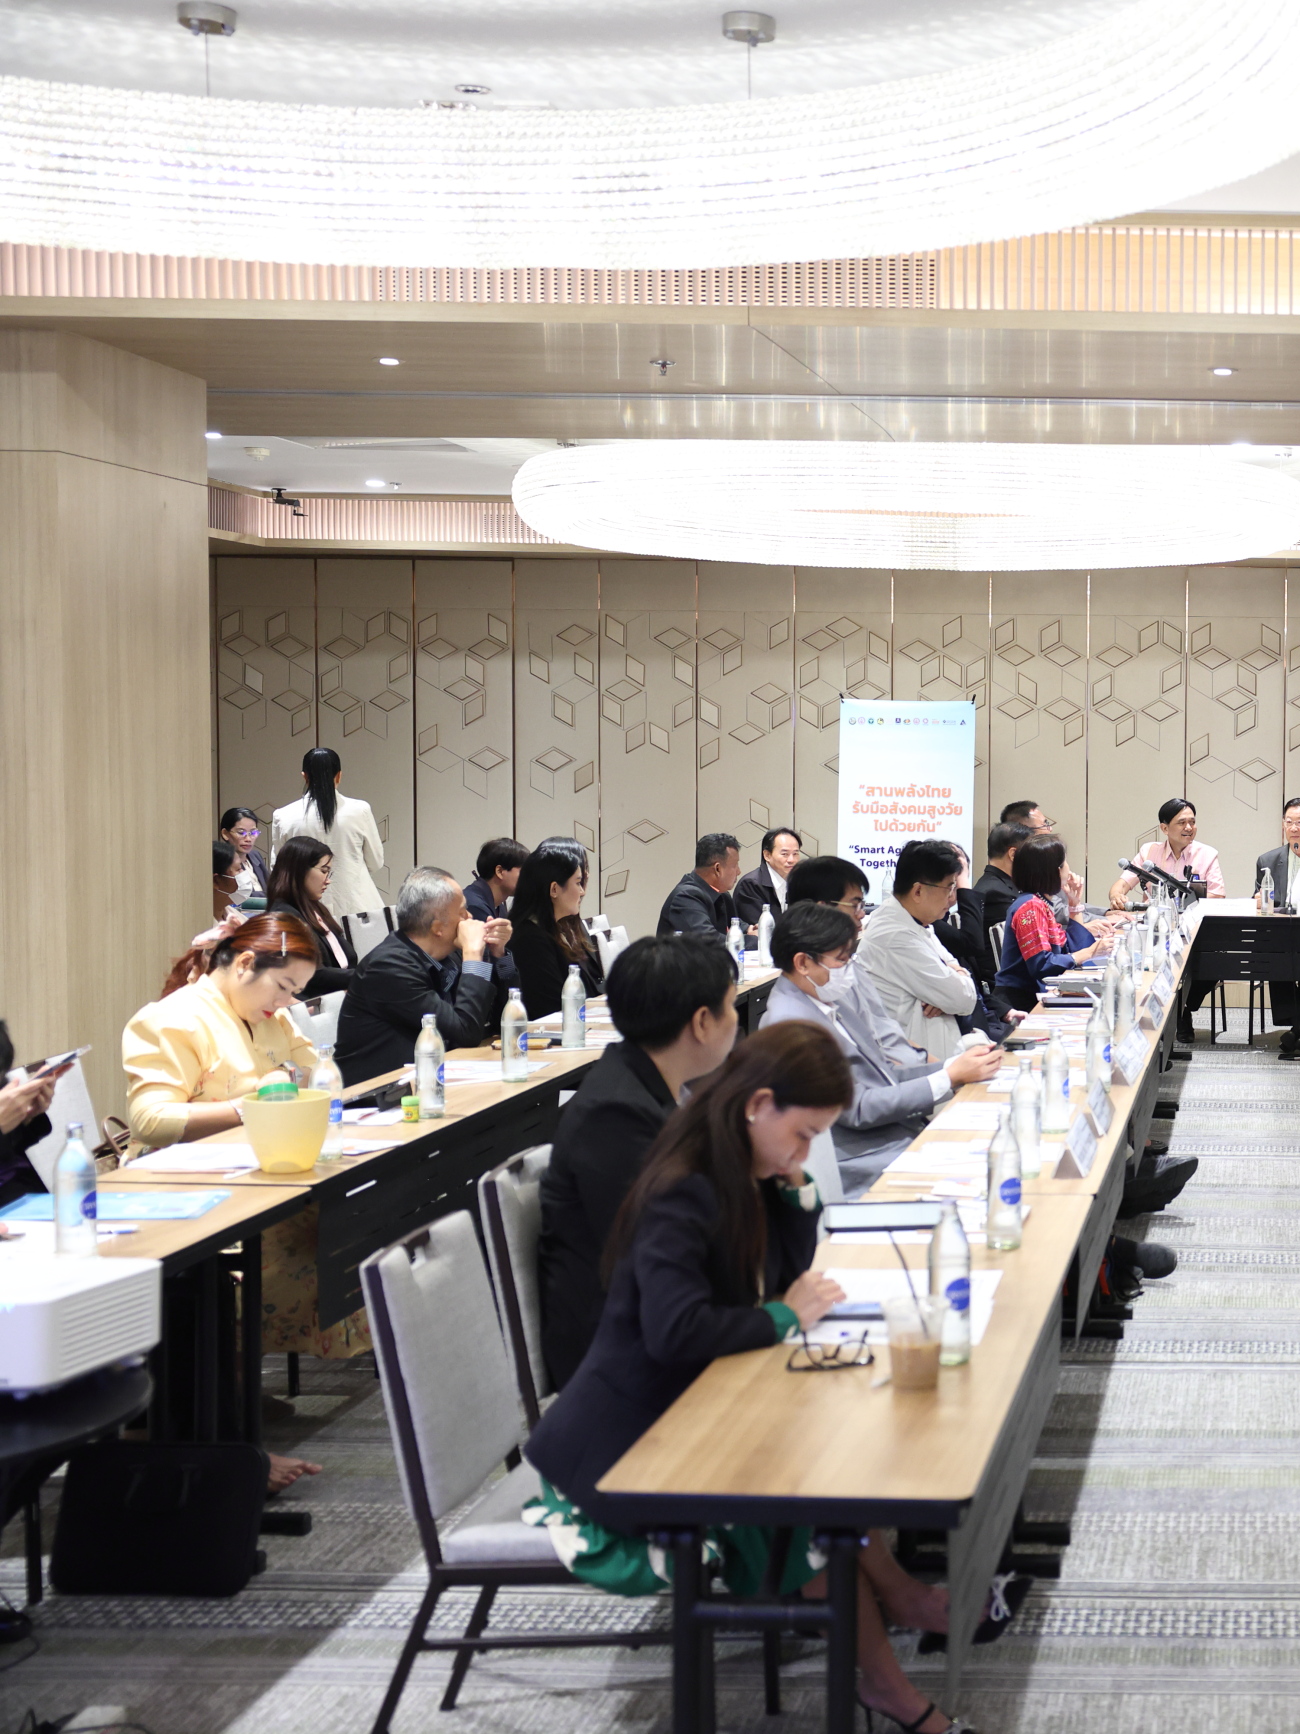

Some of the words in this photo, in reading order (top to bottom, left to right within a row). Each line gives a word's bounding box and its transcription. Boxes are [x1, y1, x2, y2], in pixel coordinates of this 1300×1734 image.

[852, 801, 963, 819] รับมือสังคมสูงวัย
[849, 845, 885, 854] “Smart
[860, 858, 897, 870] Togeth
